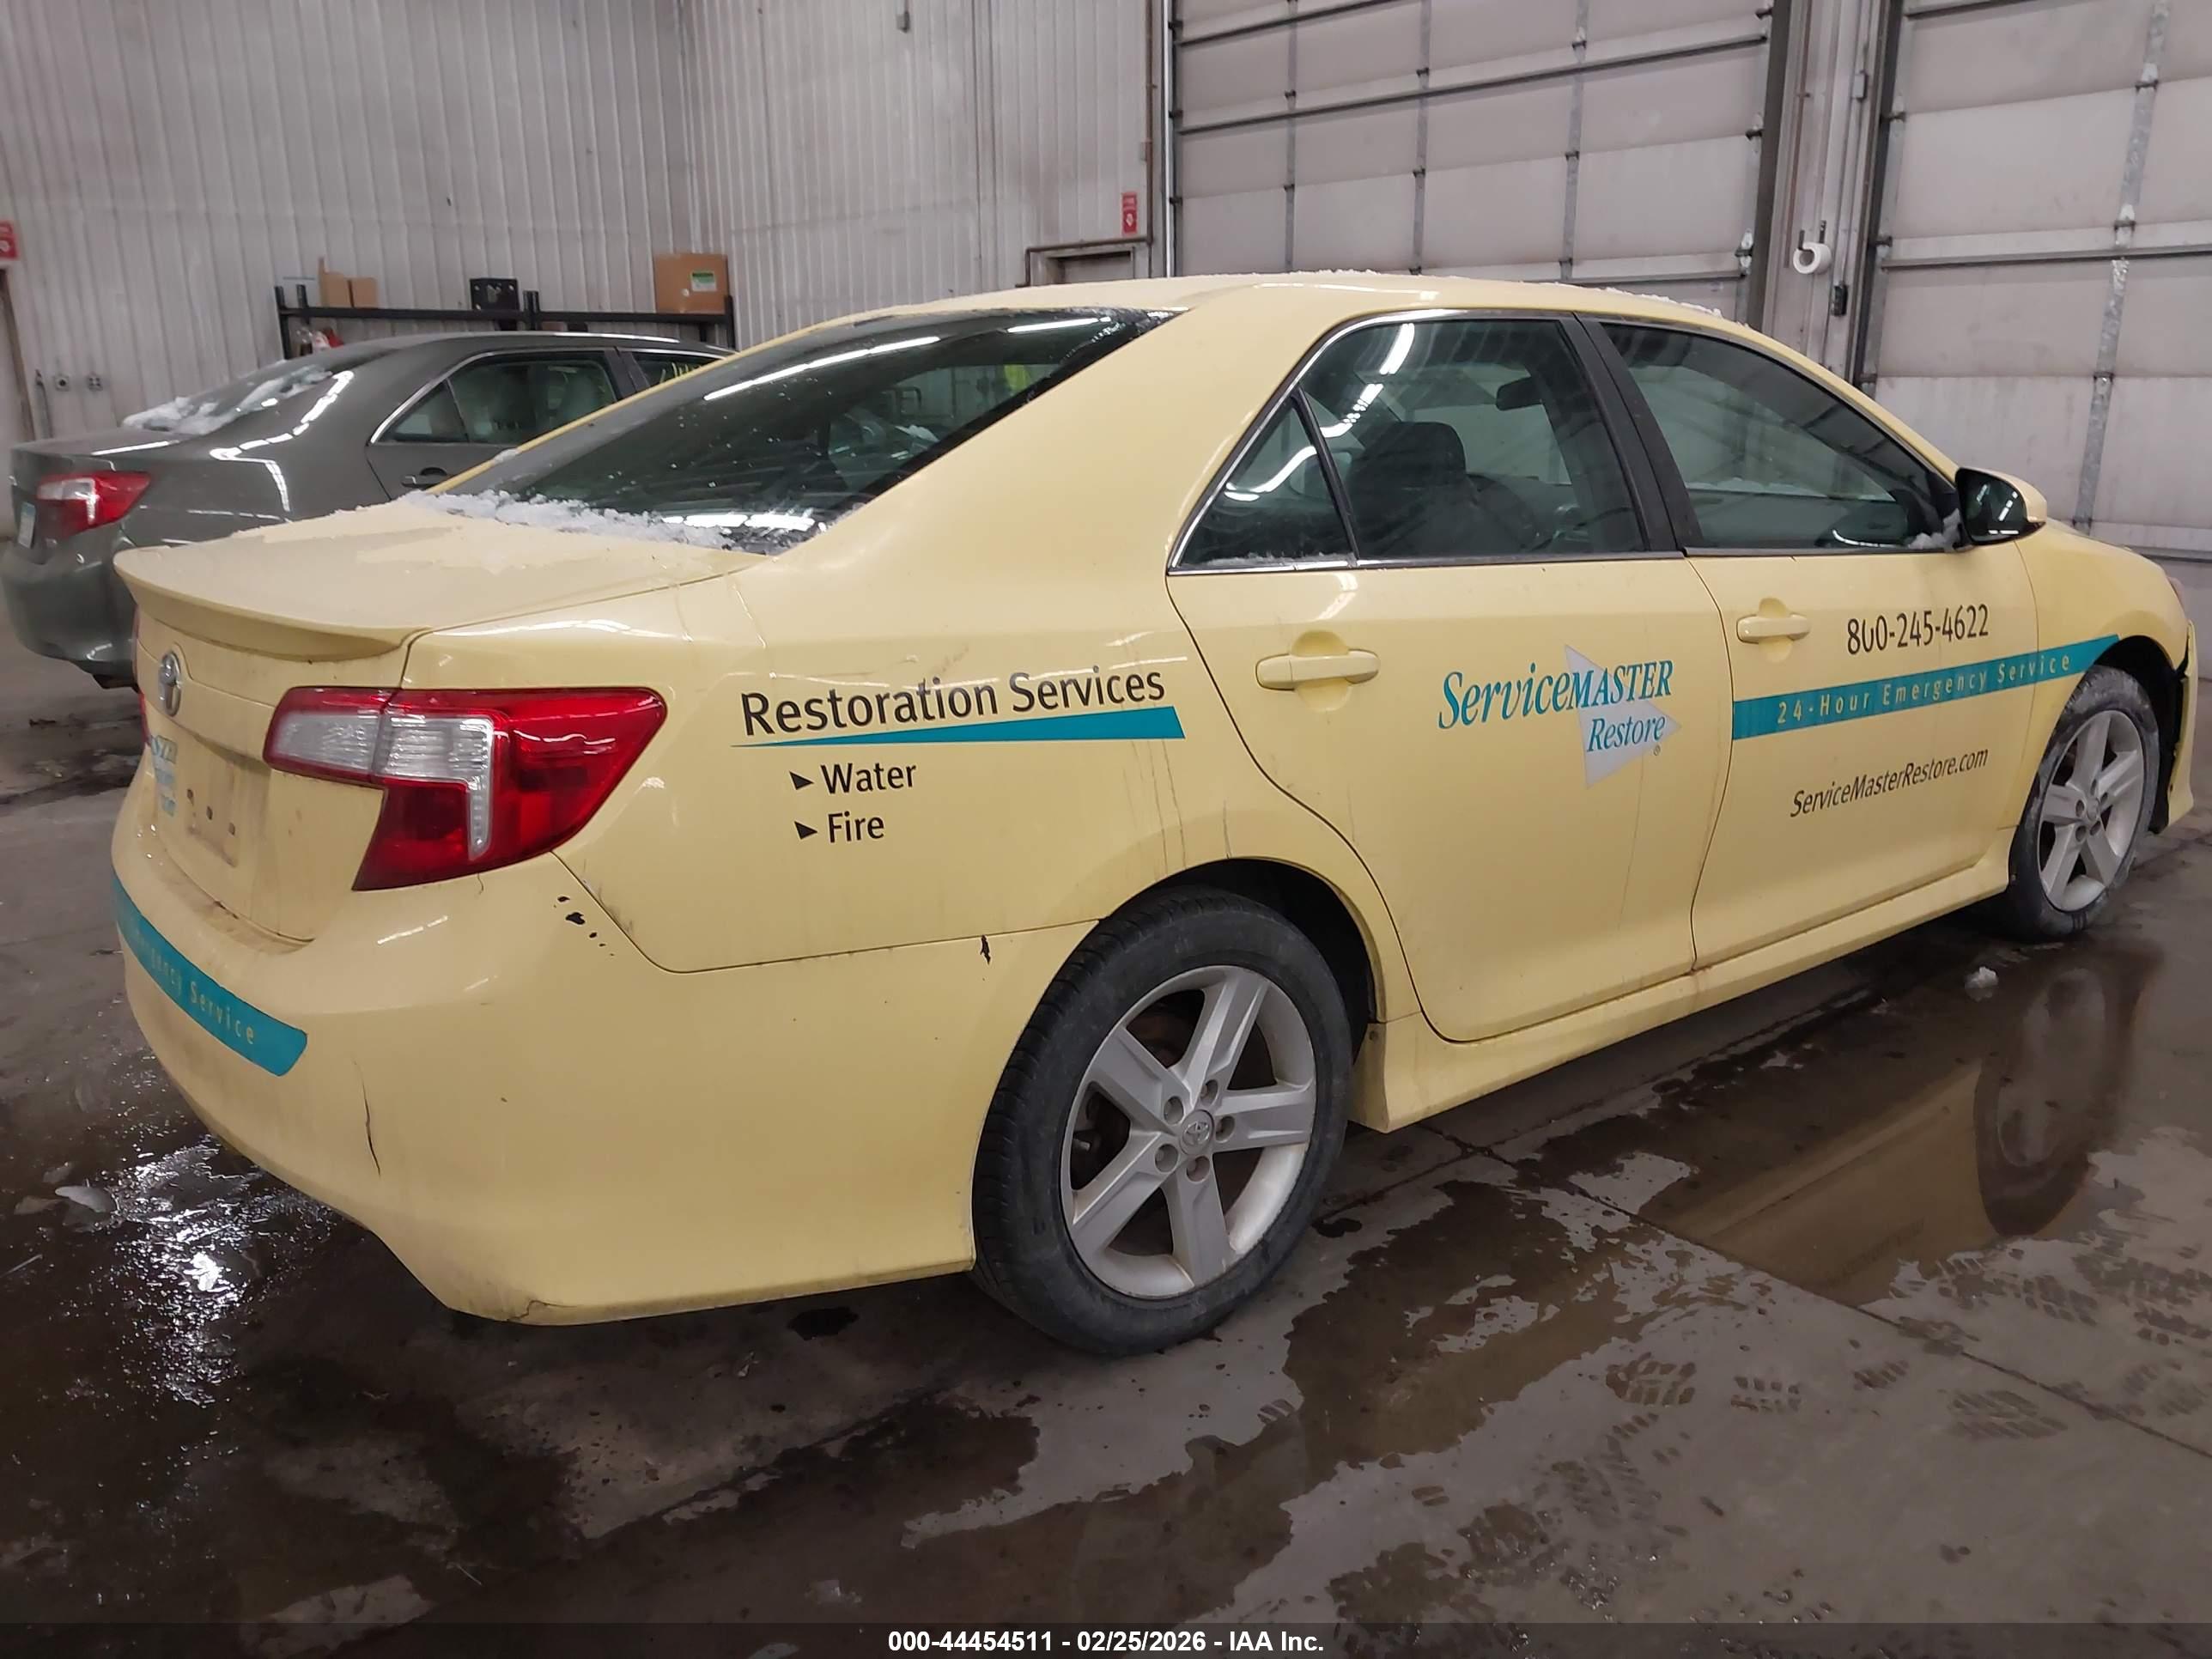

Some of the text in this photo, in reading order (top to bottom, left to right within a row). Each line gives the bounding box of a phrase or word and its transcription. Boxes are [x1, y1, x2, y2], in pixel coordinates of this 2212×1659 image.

[1847, 604, 1989, 655] 800-245-4622
[741, 665, 1166, 736] Restoration Services
[1438, 659, 1674, 730] ServiceMASTER
[1777, 653, 2070, 724] 24-Hour Emergency Service
[820, 763, 917, 794] Water
[1790, 749, 1989, 817] ServiceMasterRestore.com
[828, 811, 884, 842] Fire
[191, 981, 254, 1044] Service
